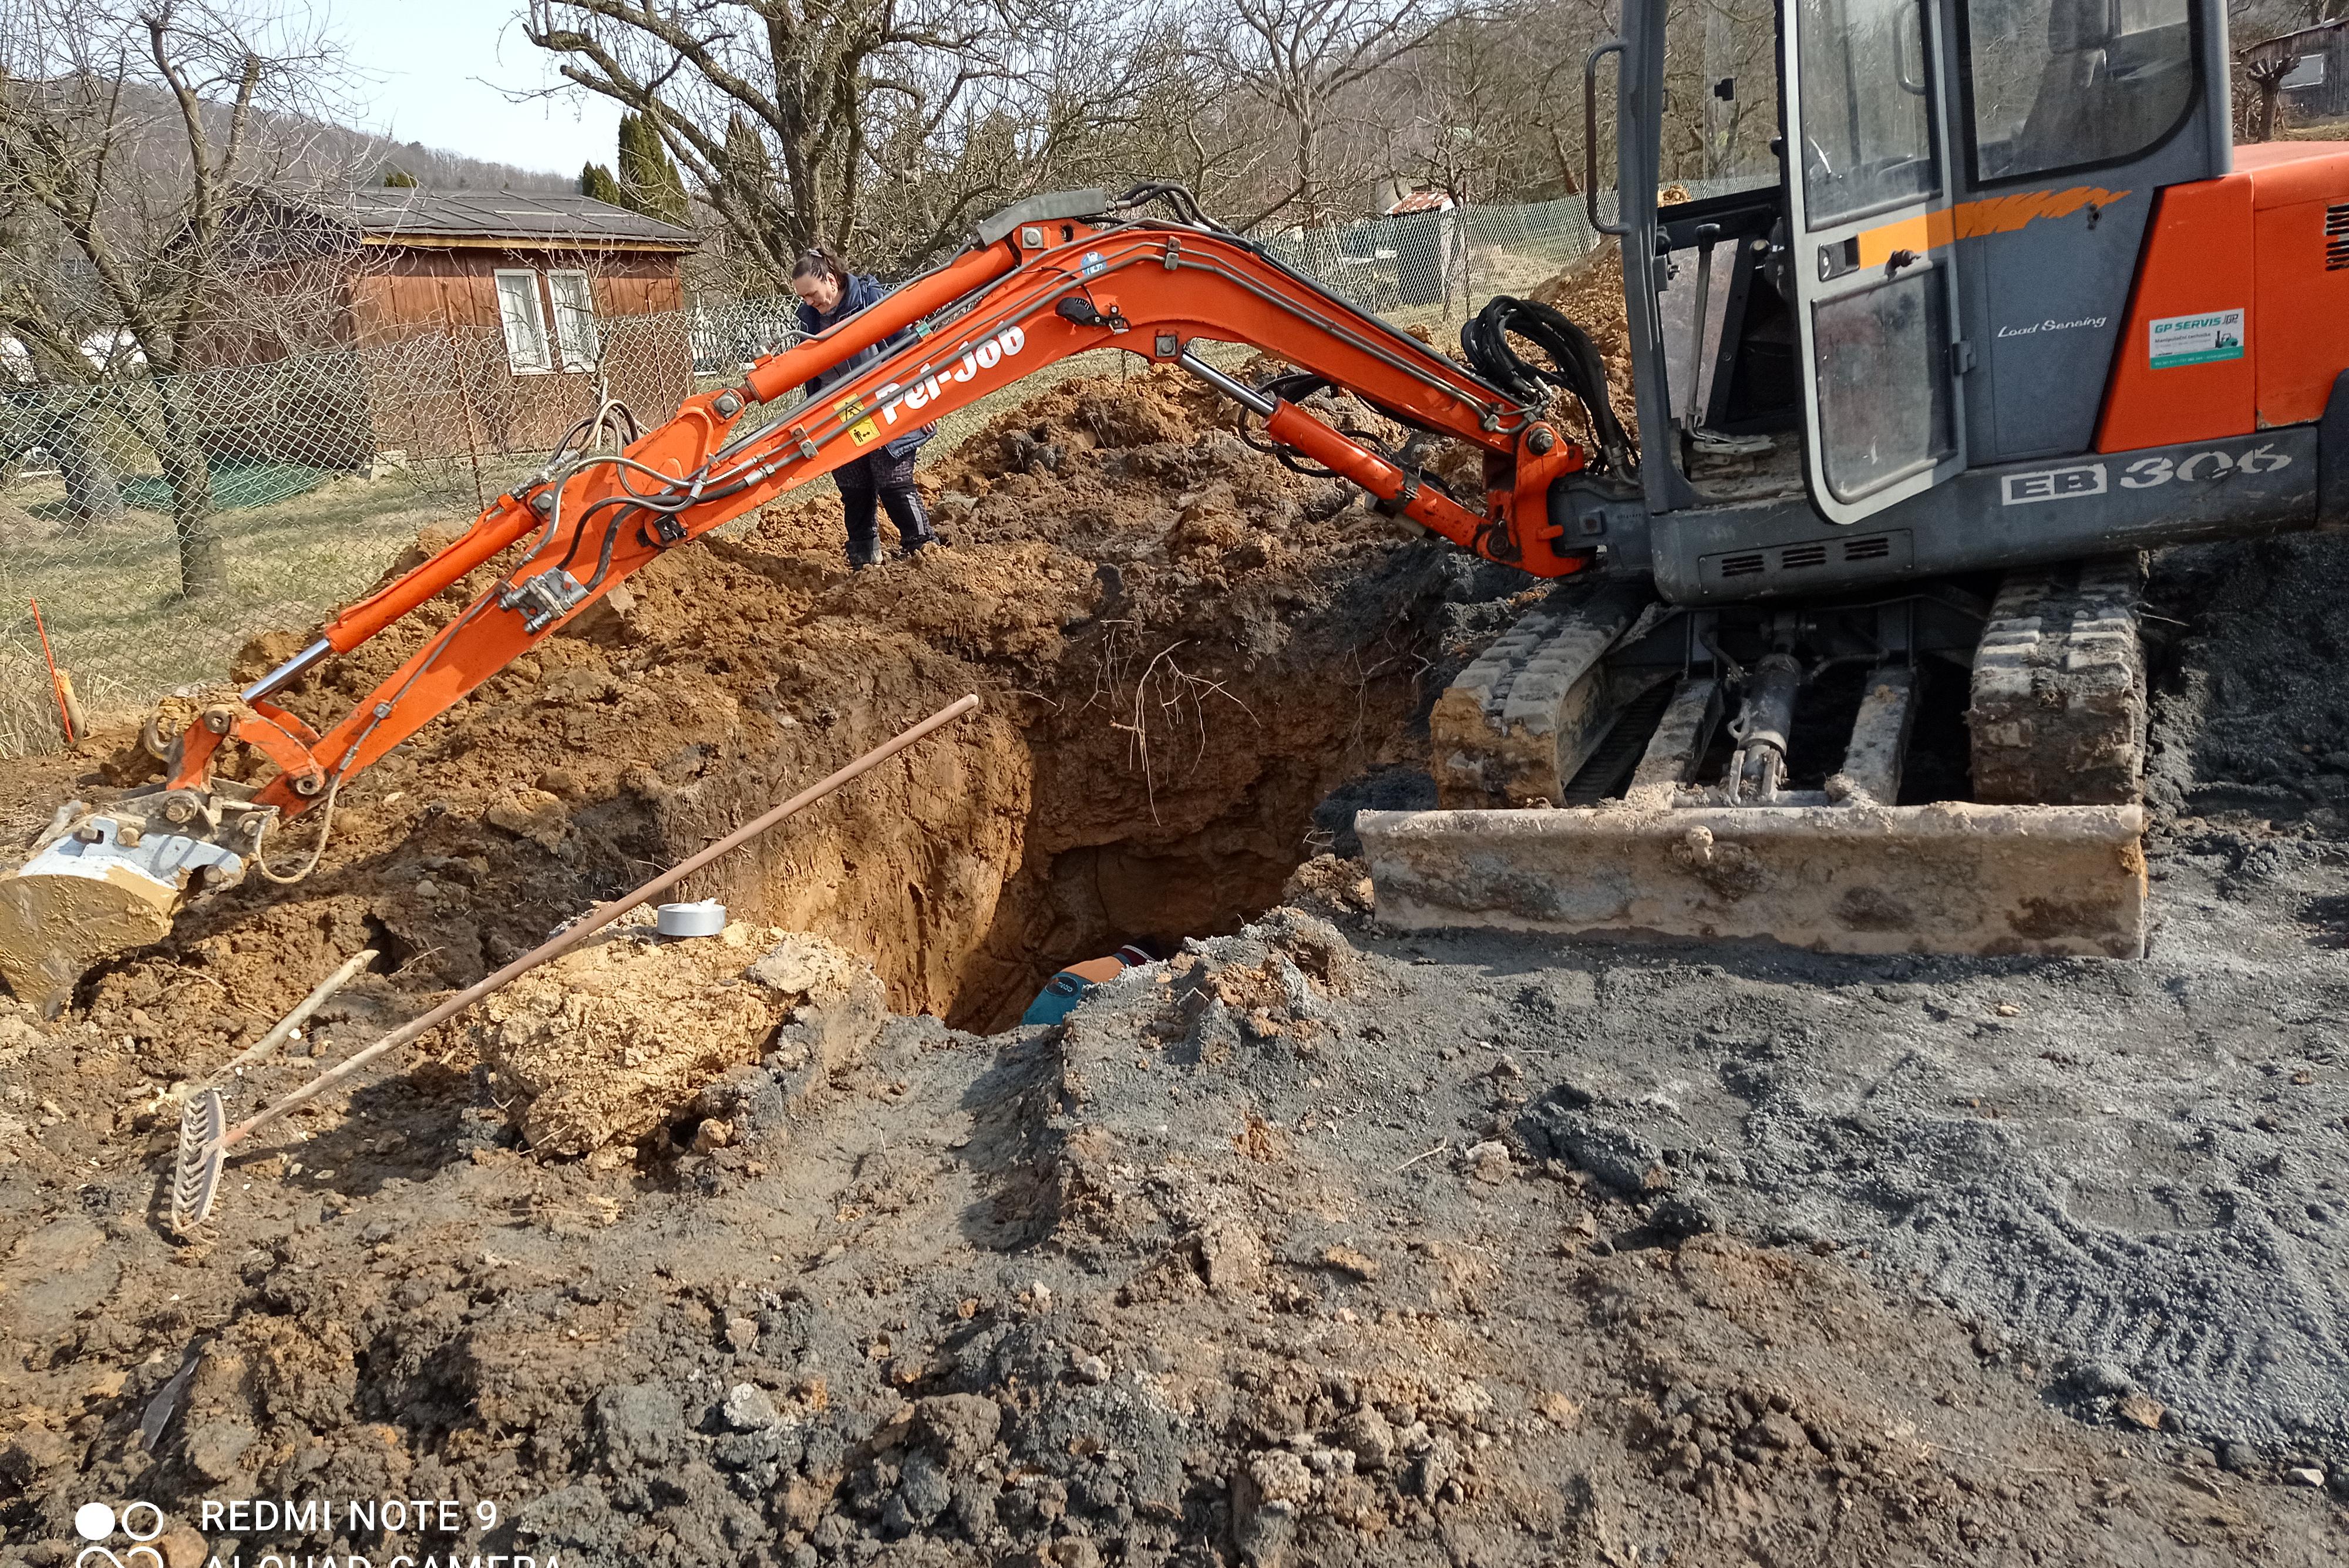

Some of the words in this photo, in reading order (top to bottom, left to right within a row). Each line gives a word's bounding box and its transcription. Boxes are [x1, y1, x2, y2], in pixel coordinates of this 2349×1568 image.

[1997, 323, 2039, 338] Load
[2041, 317, 2106, 331] Sensing
[2155, 324, 2172, 334] GP
[2175, 317, 2222, 331] SERVIS
[2008, 467, 2101, 502] EB
[2120, 443, 2292, 489] 306
